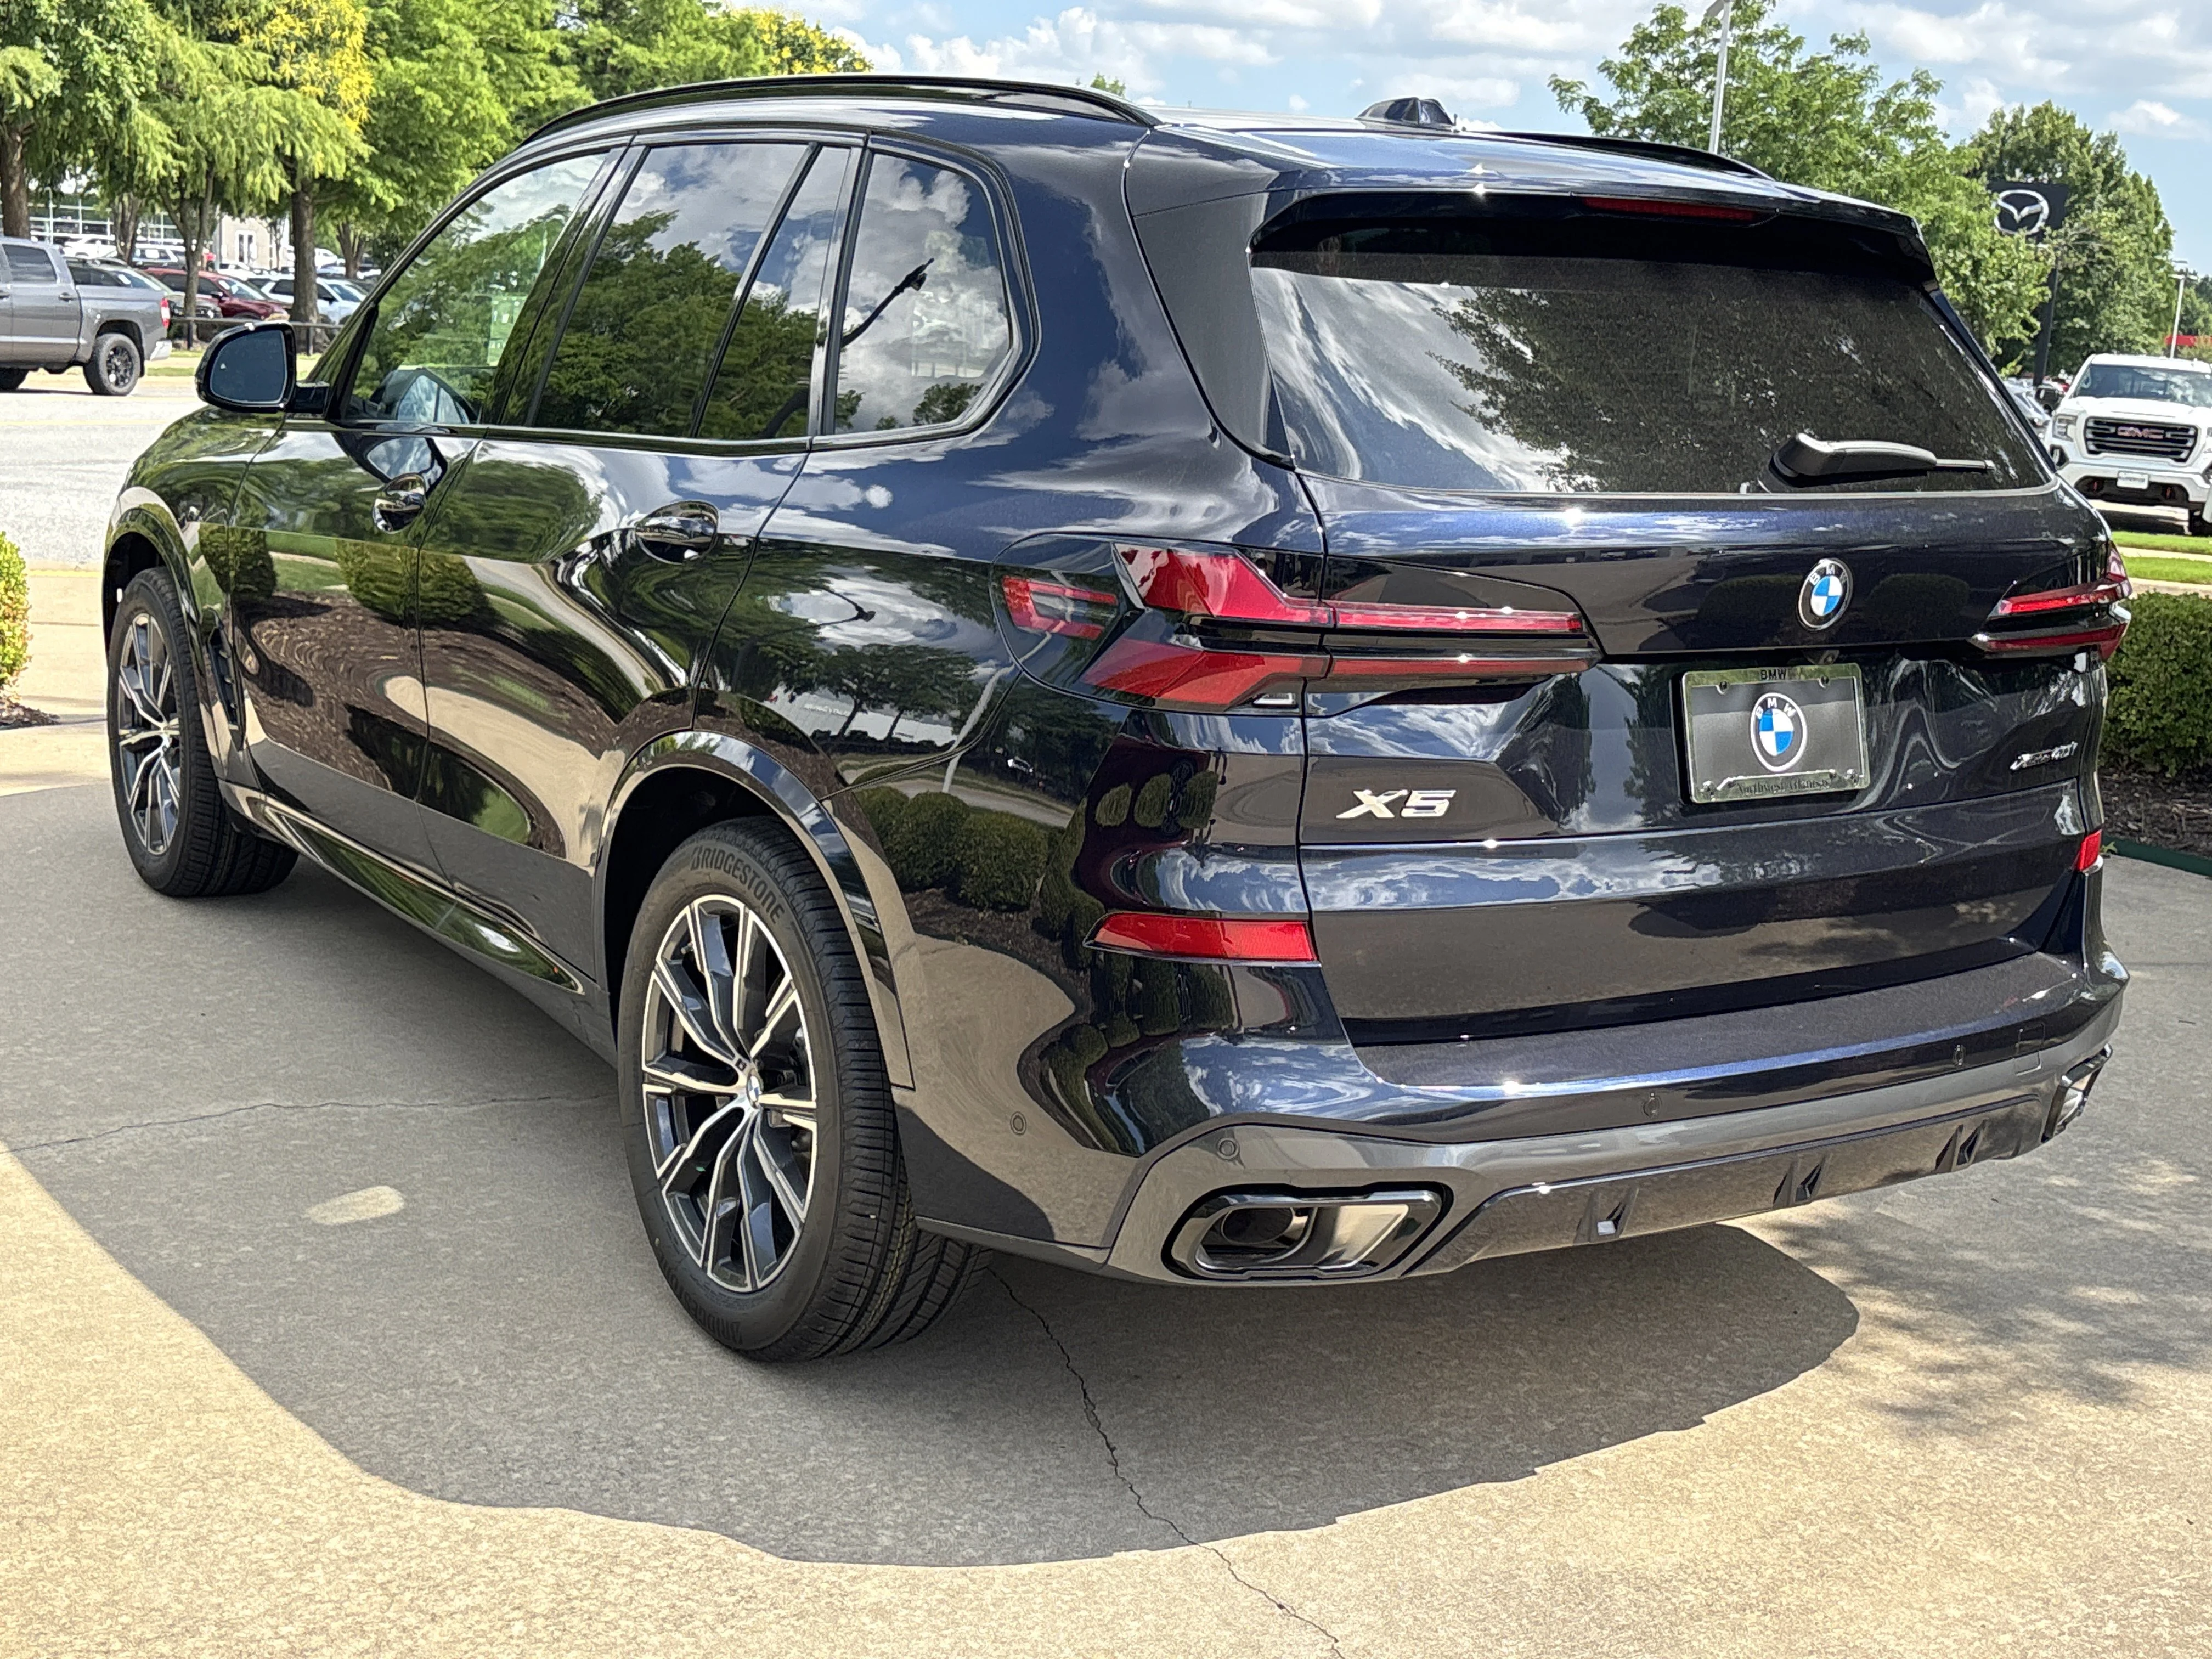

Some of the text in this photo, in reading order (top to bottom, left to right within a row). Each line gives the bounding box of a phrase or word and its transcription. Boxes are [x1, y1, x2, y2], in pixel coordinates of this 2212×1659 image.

[2117, 426, 2164, 439] GMC
[1760, 669, 1786, 680] BMW
[1756, 697, 1796, 720] BMW
[1335, 789, 1457, 819] X5
[690, 845, 786, 924] BRIDGESTONE
